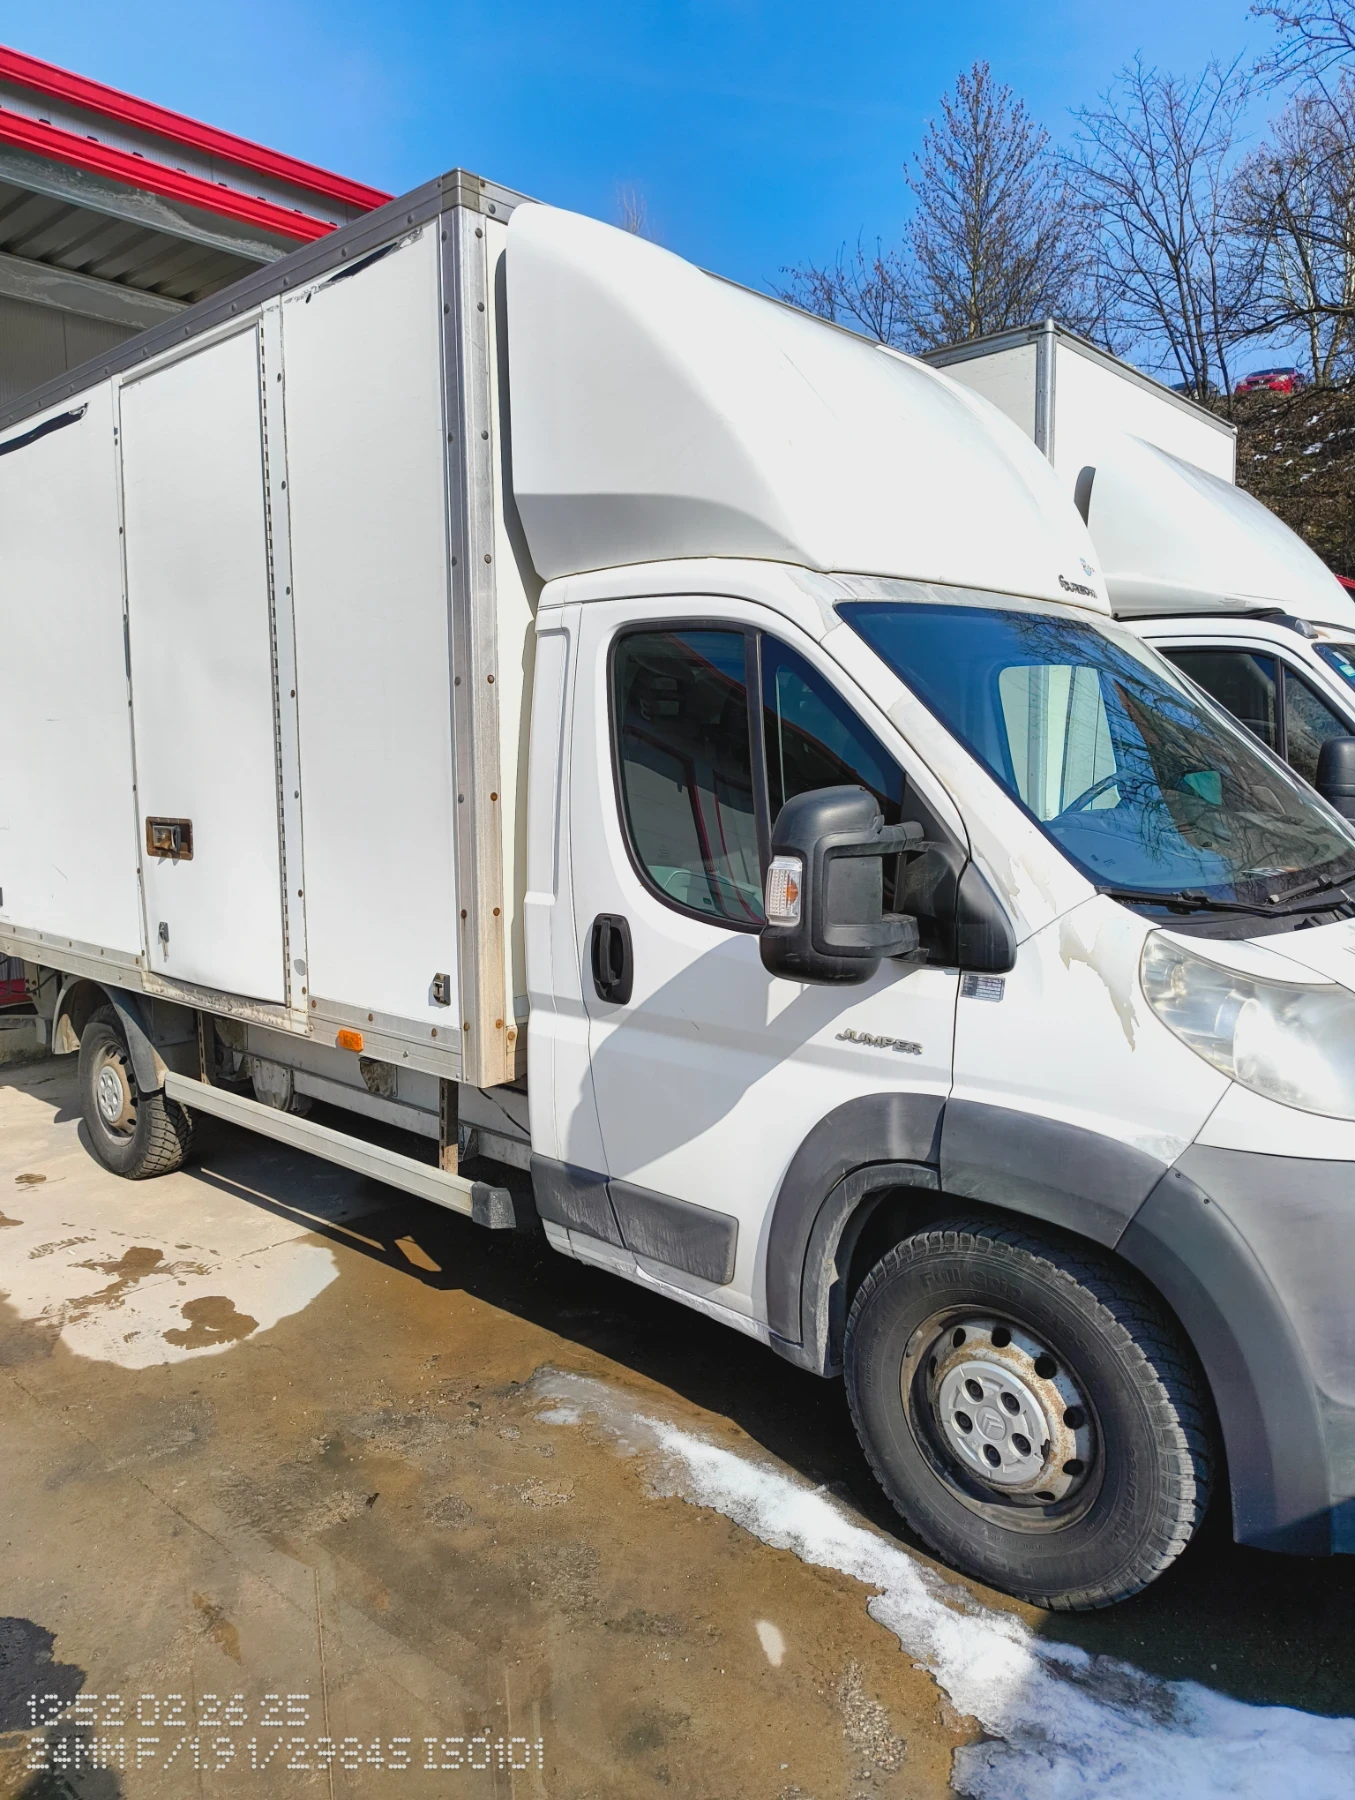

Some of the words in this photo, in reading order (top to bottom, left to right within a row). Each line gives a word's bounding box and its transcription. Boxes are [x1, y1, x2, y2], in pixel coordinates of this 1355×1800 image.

[835, 1028, 923, 1055] JUMPER
[918, 1267, 963, 1294] Full
[968, 1270, 1024, 1300] Grip
